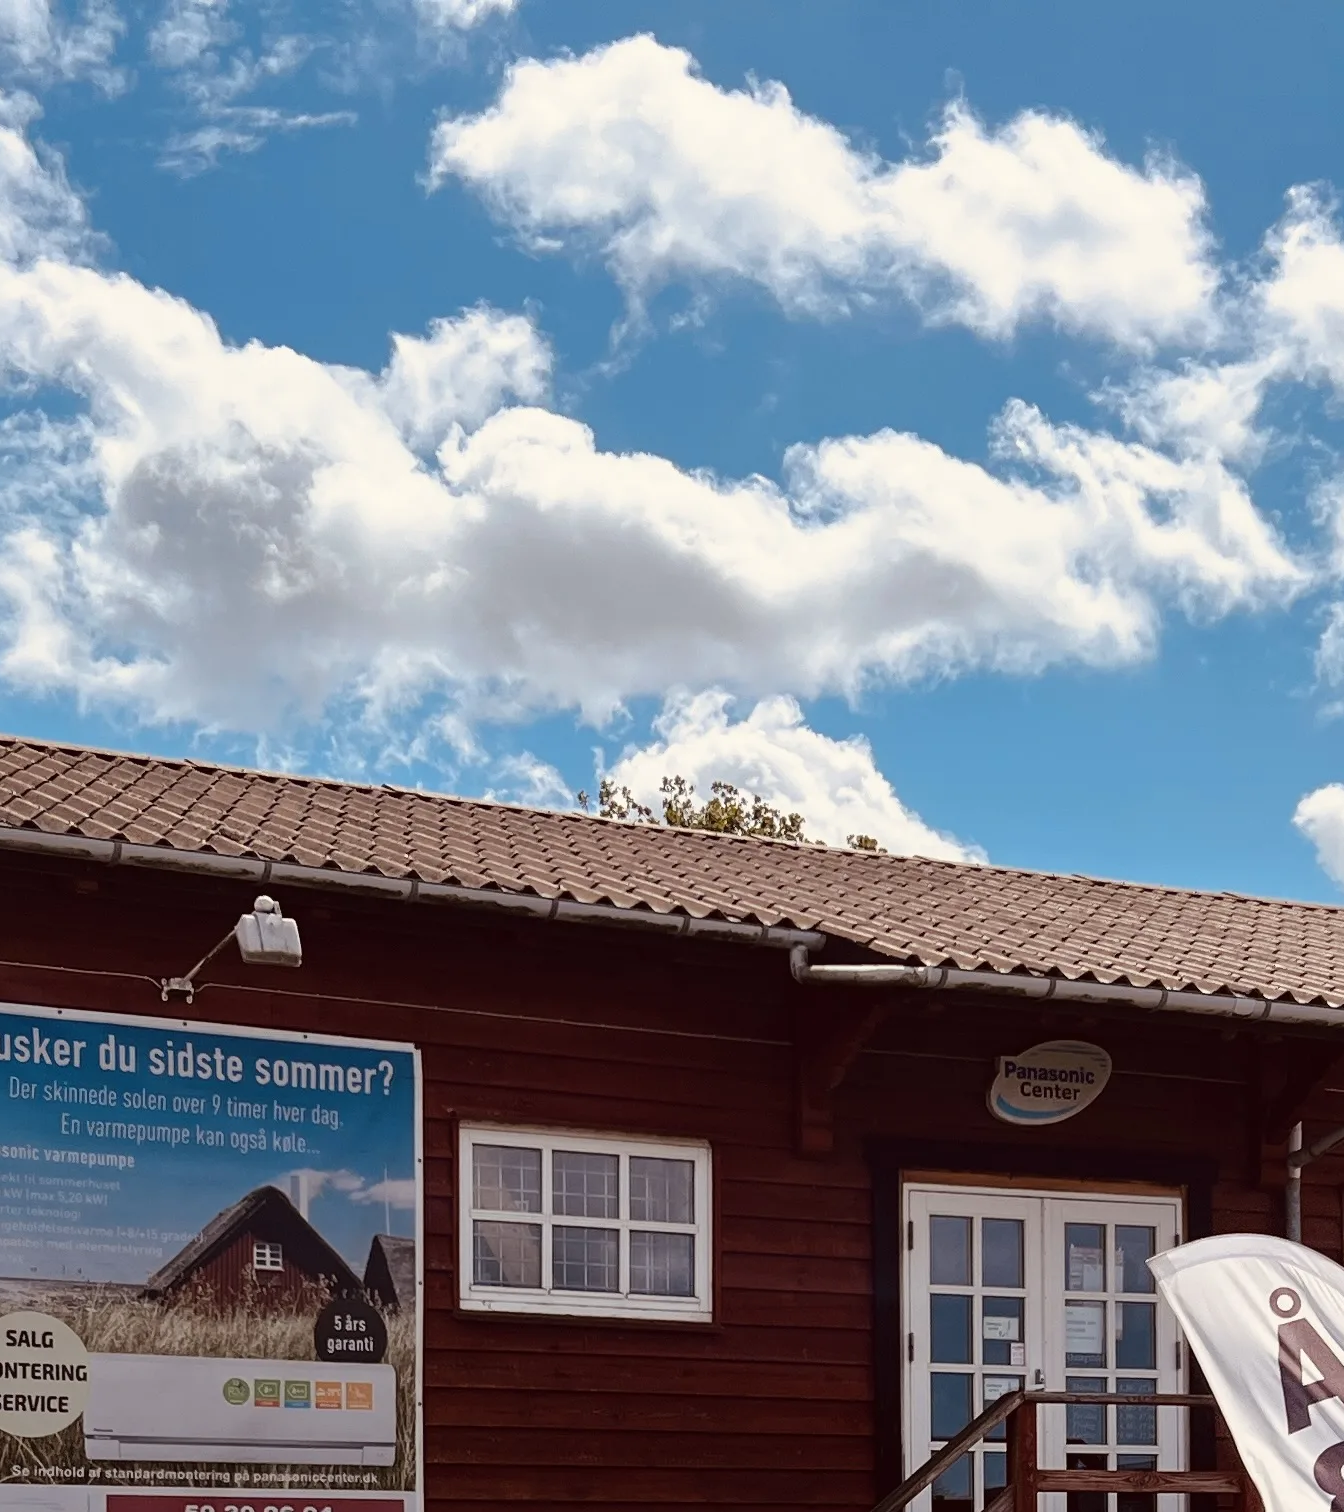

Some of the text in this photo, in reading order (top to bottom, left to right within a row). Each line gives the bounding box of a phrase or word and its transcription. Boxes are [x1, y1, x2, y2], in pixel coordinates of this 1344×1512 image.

[99, 1037, 136, 1073] du
[150, 1040, 243, 1083] sidste
[256, 1060, 395, 1096] sommer?
[1004, 1061, 1095, 1085] Panasonic
[9, 1077, 36, 1100] Der
[43, 1080, 117, 1108] skinnede
[123, 1086, 167, 1111] solen
[172, 1094, 206, 1115] over
[212, 1094, 222, 1115] 9
[227, 1096, 268, 1120] timer
[273, 1099, 306, 1123] hver
[1020, 1082, 1081, 1101] Center
[61, 1114, 321, 1156] En varmepumpe kan også køle...
[44, 1149, 136, 1170] varmepumpe
[3, 1188, 23, 1199] kW
[24, 1175, 36, 1186] til
[39, 1177, 121, 1192] sommerhuset
[26, 1205, 82, 1220] teknologi
[46, 1240, 73, 1251] med
[76, 1242, 163, 1258] internetstyring
[334, 1314, 366, 1333] 5 års
[5, 1329, 54, 1349] SALG
[327, 1335, 374, 1356] garanti
[11, 1464, 378, 1487] Se indhold af standardmontering på panasoniccenter.dk
